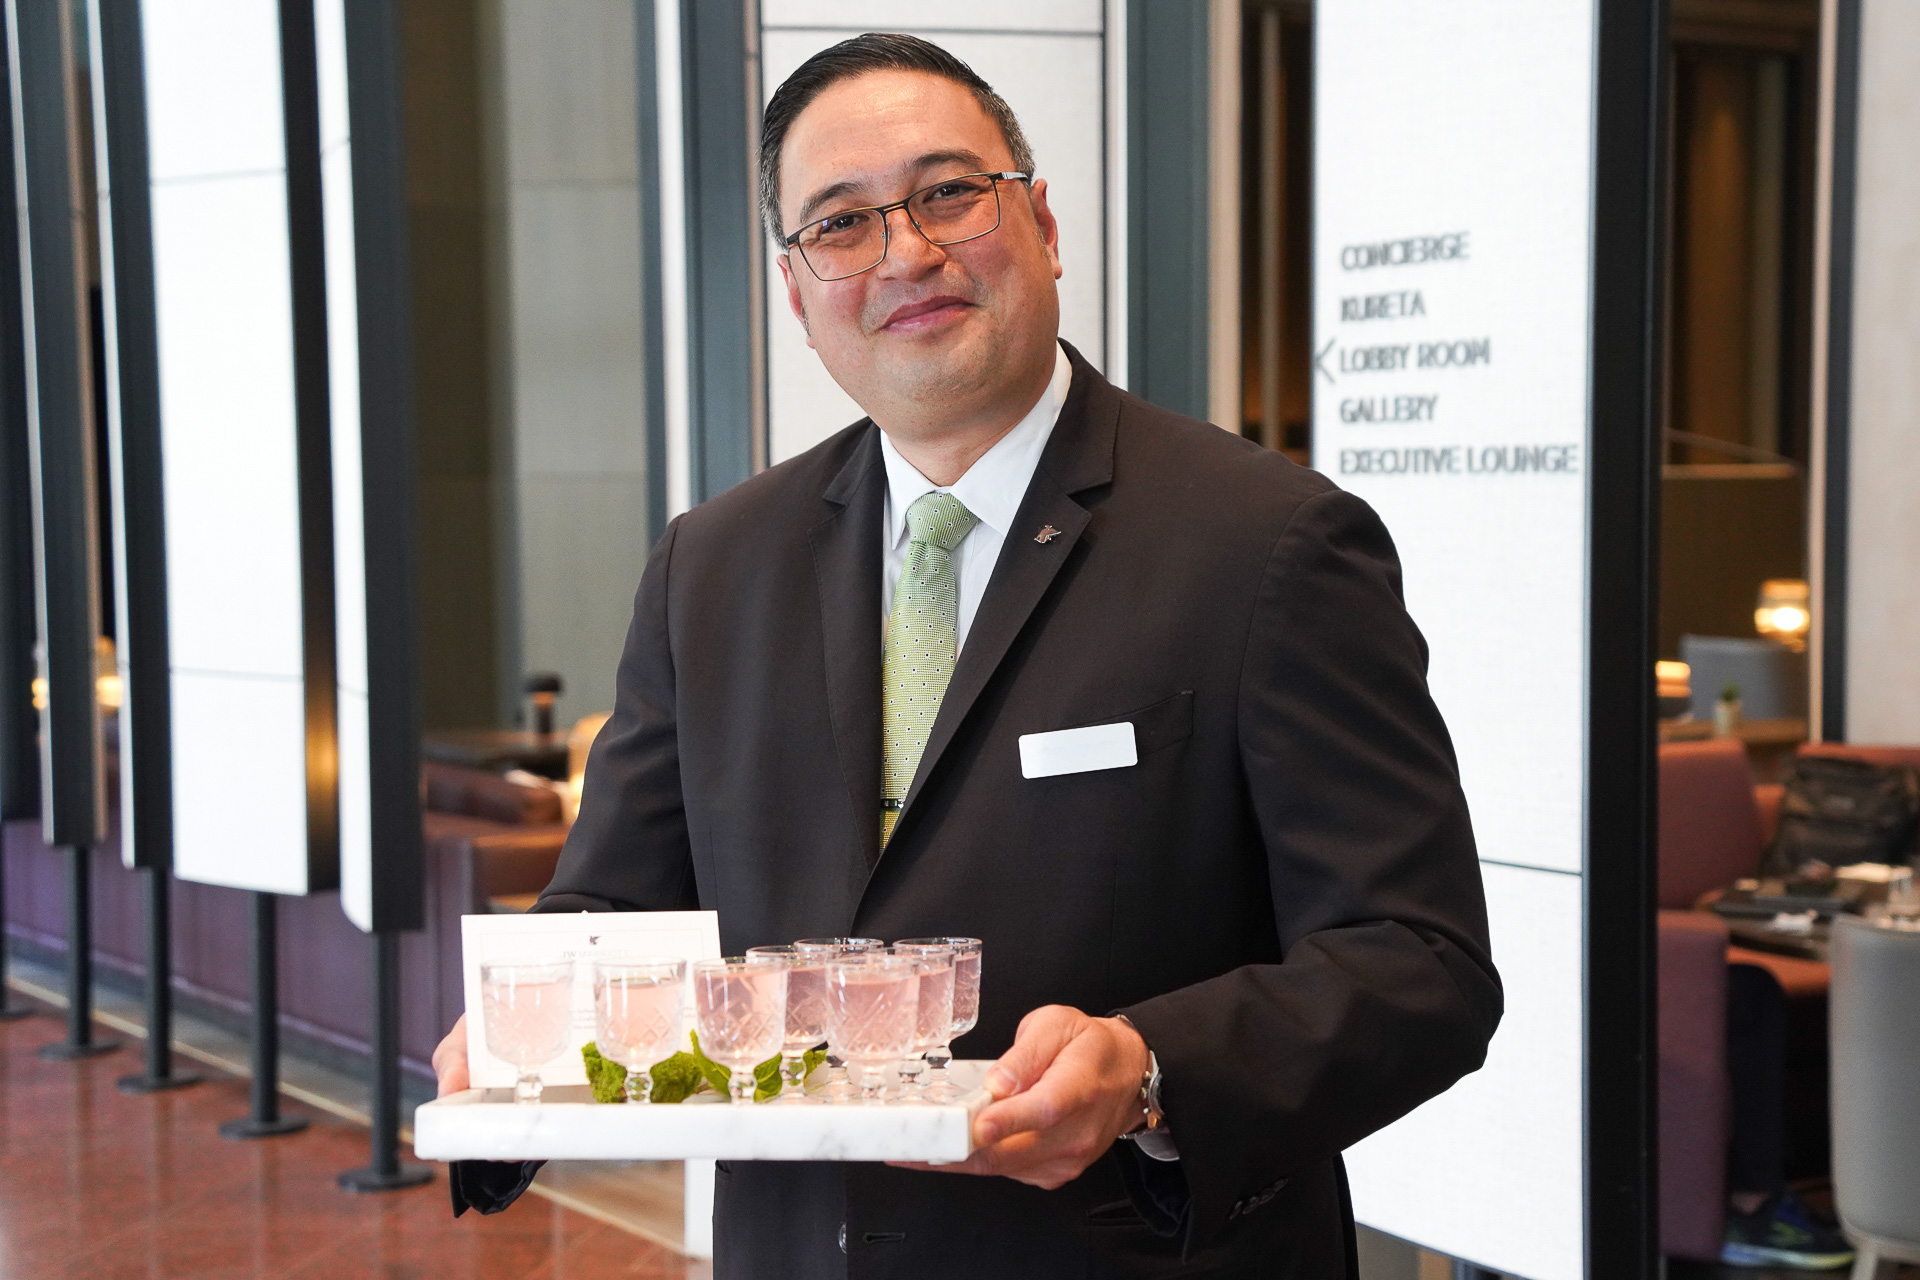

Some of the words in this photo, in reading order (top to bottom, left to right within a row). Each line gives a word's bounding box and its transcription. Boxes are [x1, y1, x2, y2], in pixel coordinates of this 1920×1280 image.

[1341, 231, 1471, 271] CONCIERGE
[1340, 344, 1412, 373] LOBBY
[1417, 337, 1491, 367] ROOM
[1340, 393, 1438, 423] GALLERY
[1340, 446, 1462, 475] EXECUTIVE
[1466, 444, 1579, 473] LOUNGE
